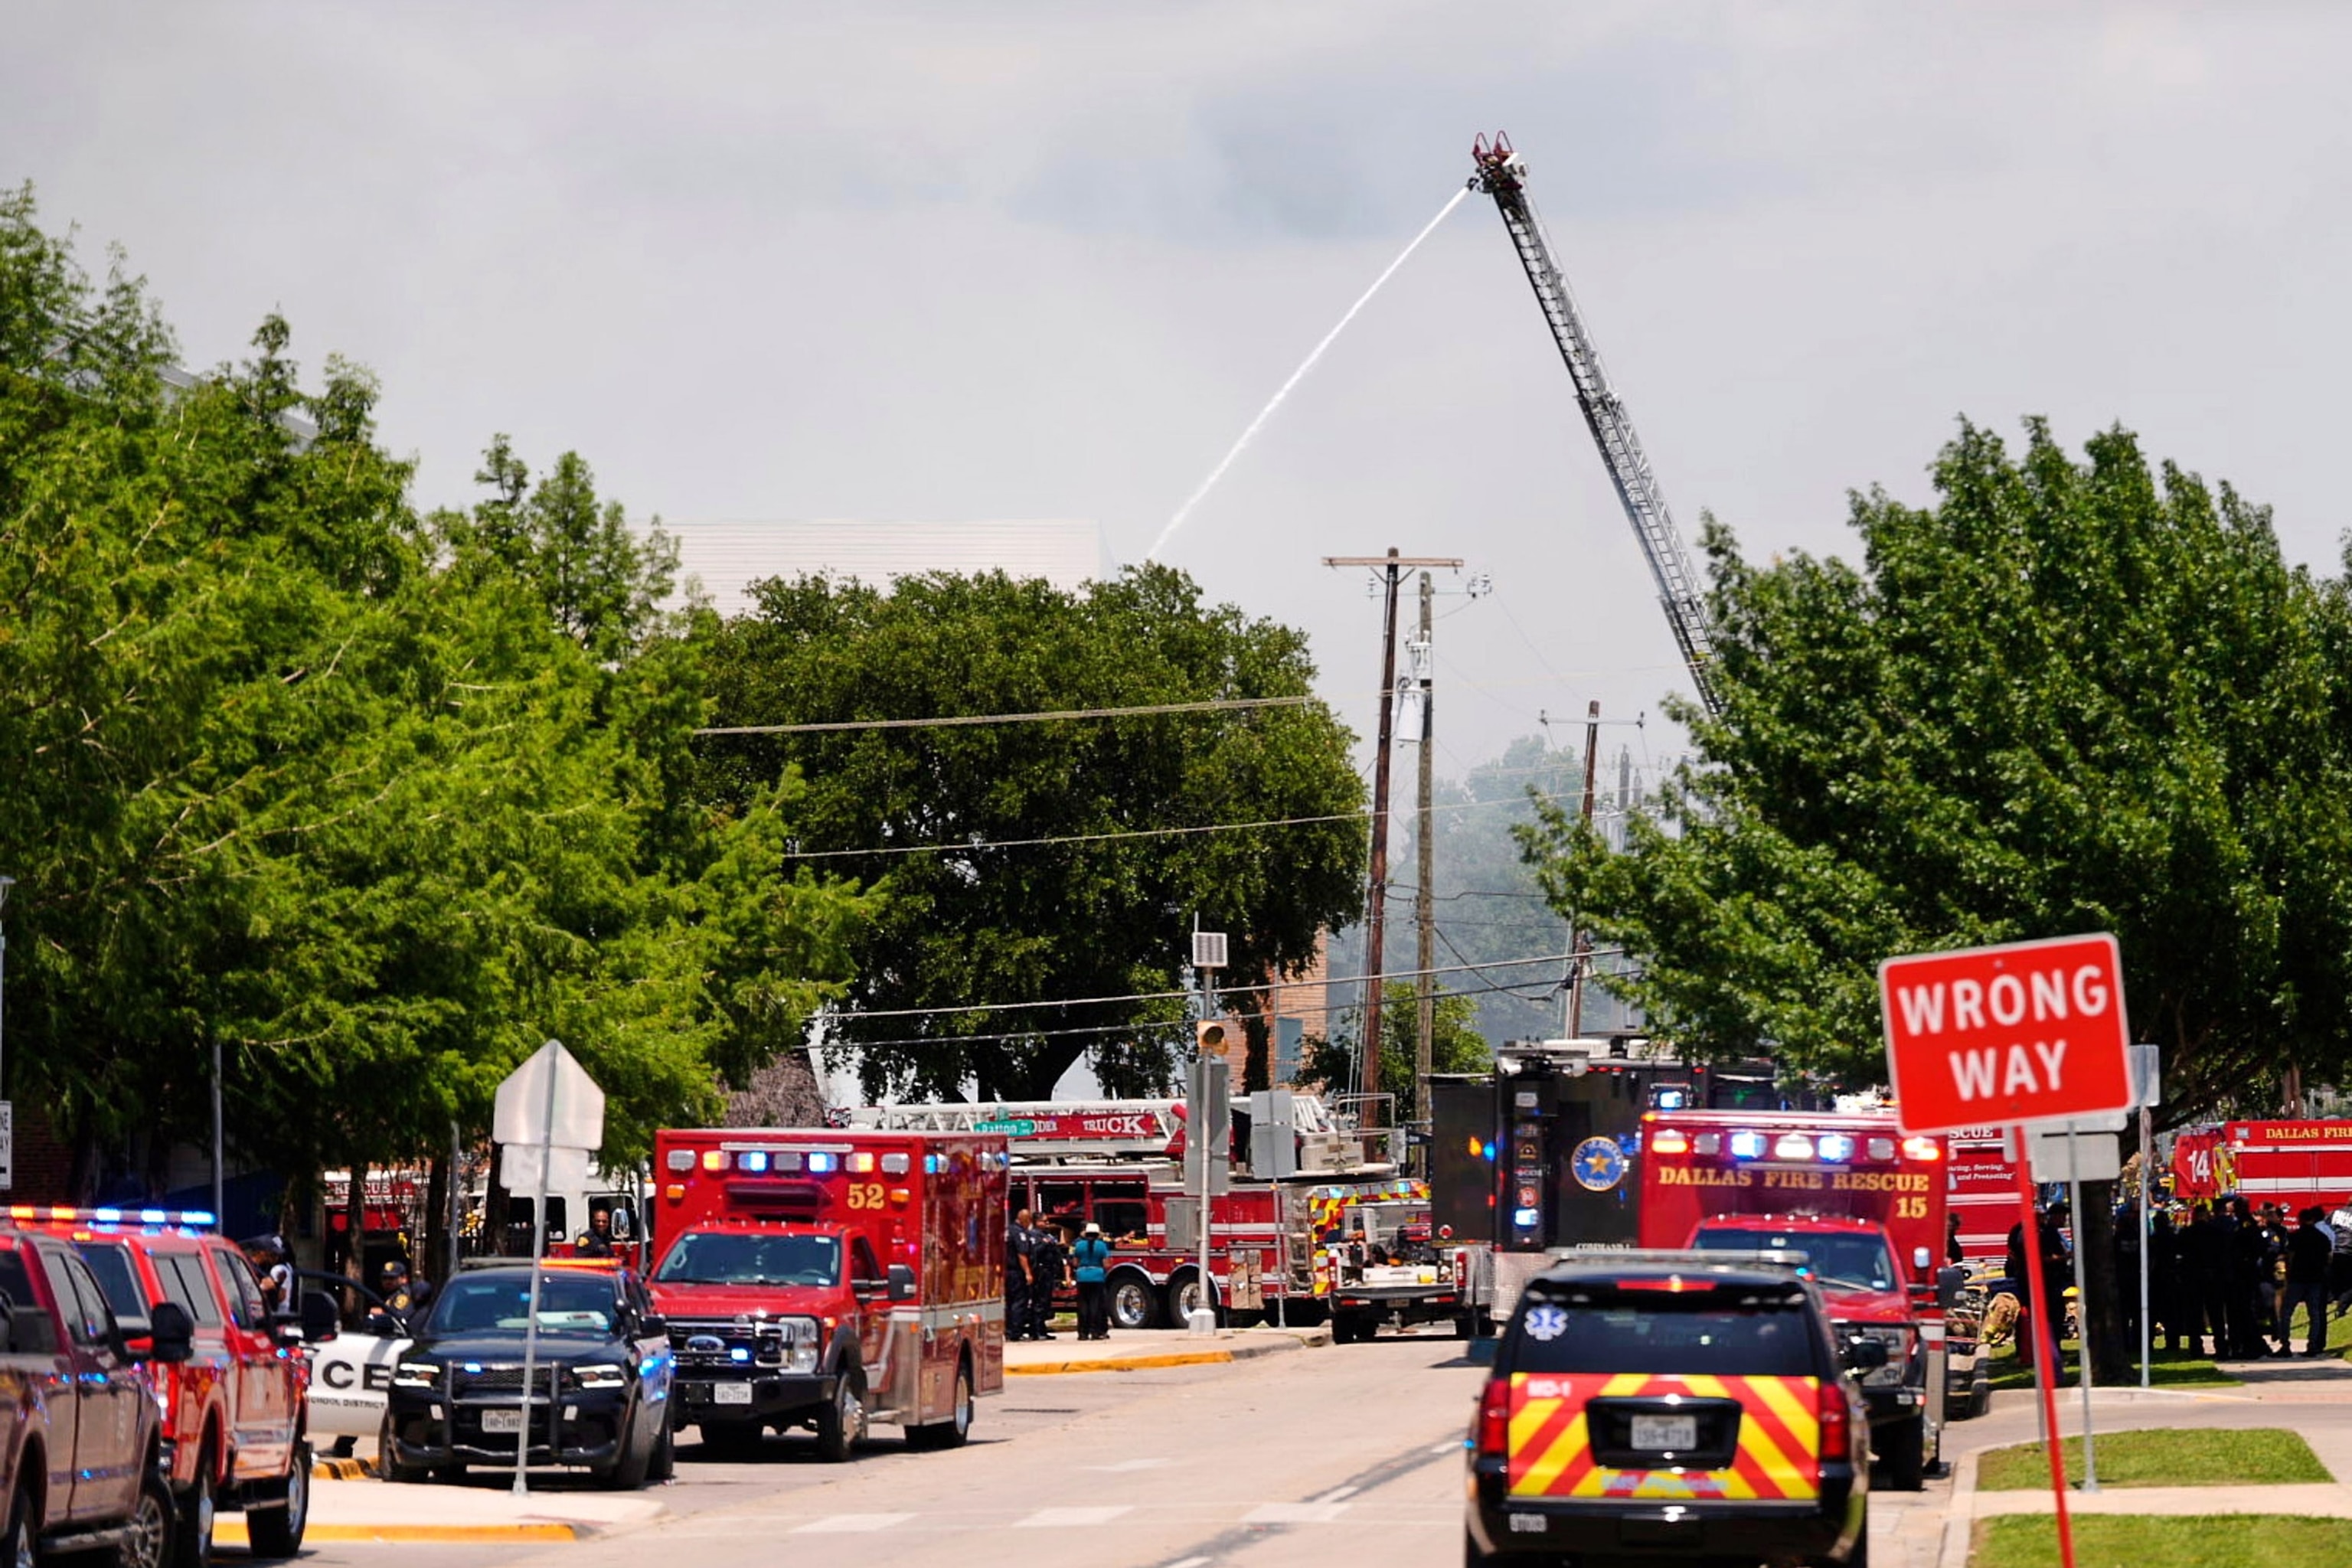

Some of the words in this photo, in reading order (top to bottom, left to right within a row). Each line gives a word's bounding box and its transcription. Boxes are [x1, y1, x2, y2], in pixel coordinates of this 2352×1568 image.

[1896, 964, 2108, 1037] WRONG
[1949, 1039, 2066, 1102] WAY
[1083, 1115, 1147, 1135] TRUCK
[2265, 1128, 2319, 1139] DALLAS
[1658, 1166, 1753, 1186] DALLAS
[1763, 1171, 1823, 1189] FIRE
[1831, 1173, 1929, 1191] RESCUE
[2187, 1150, 2210, 1183] 14
[848, 1183, 884, 1210] 52
[1896, 1197, 1928, 1218] 15
